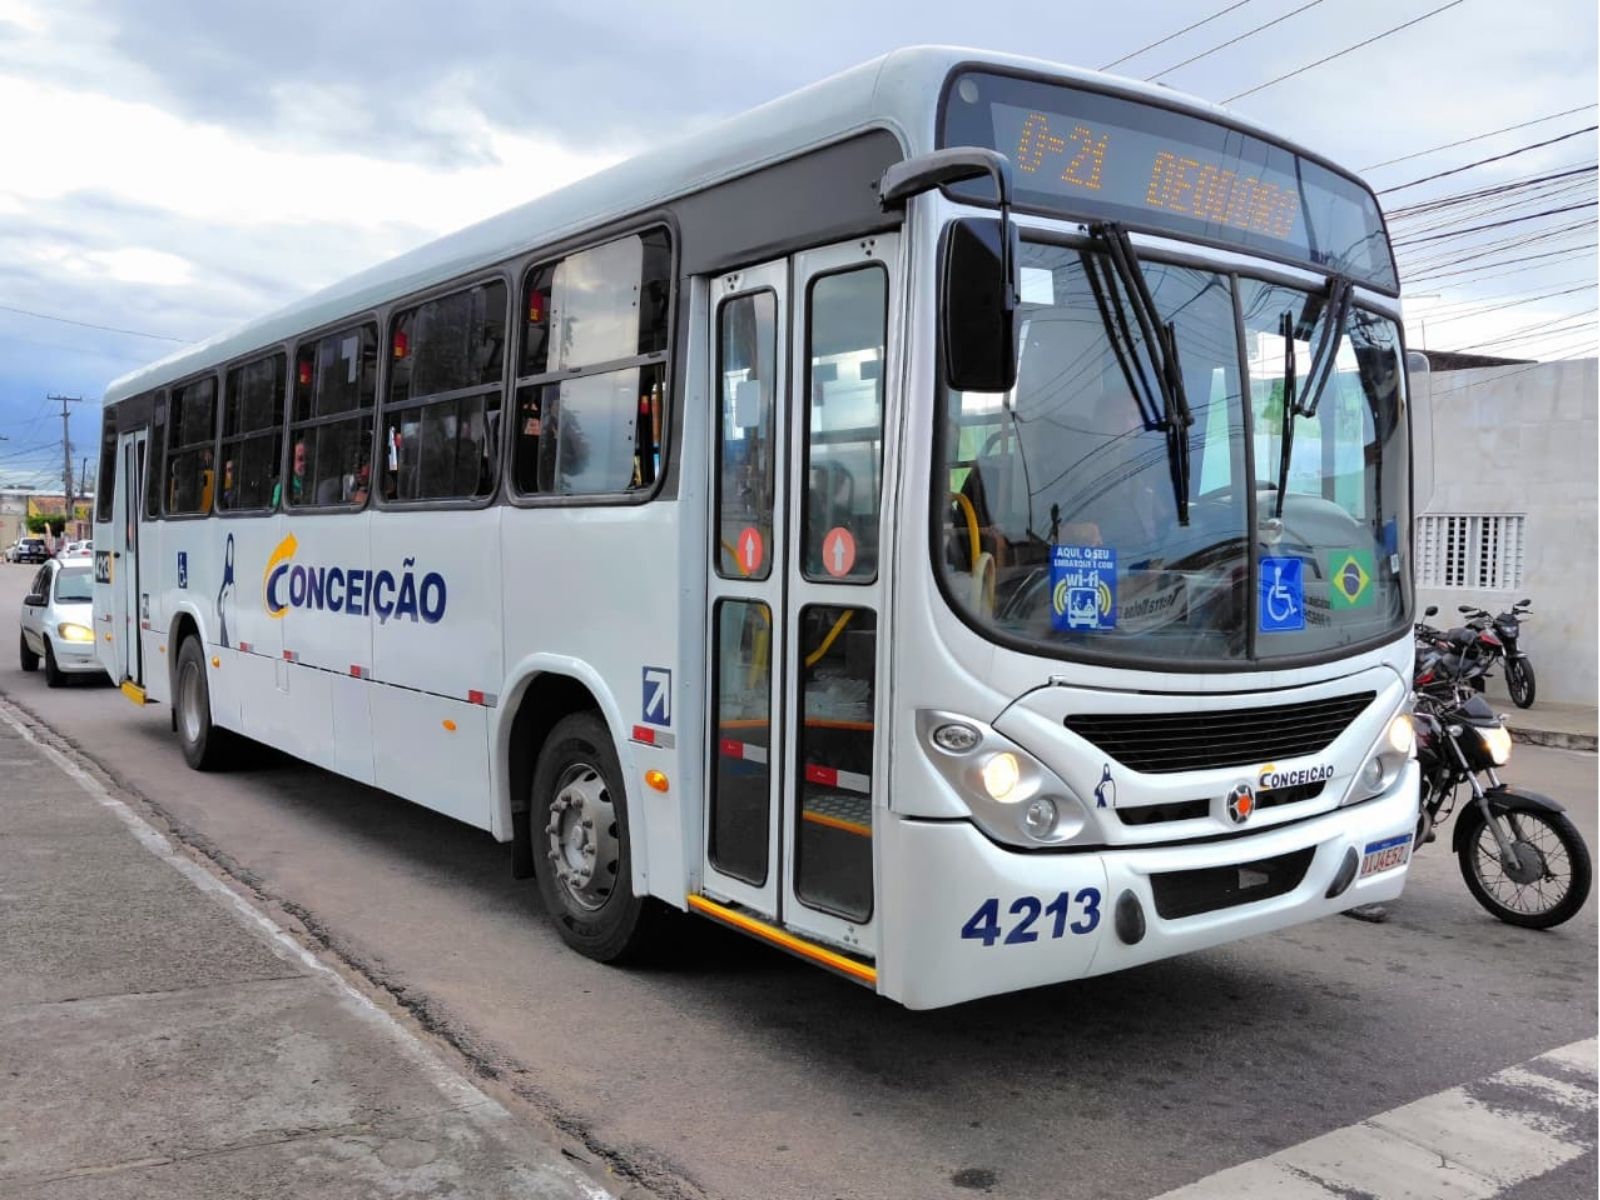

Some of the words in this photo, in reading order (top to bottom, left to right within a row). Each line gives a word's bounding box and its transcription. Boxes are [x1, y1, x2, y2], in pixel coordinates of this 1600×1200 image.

[1084, 548, 1091, 558] O
[1093, 549, 1109, 560] SEU
[266, 556, 447, 625] CONCEIÇÃO
[1066, 569, 1098, 587] wi-fi
[961, 887, 1102, 946] 4213
